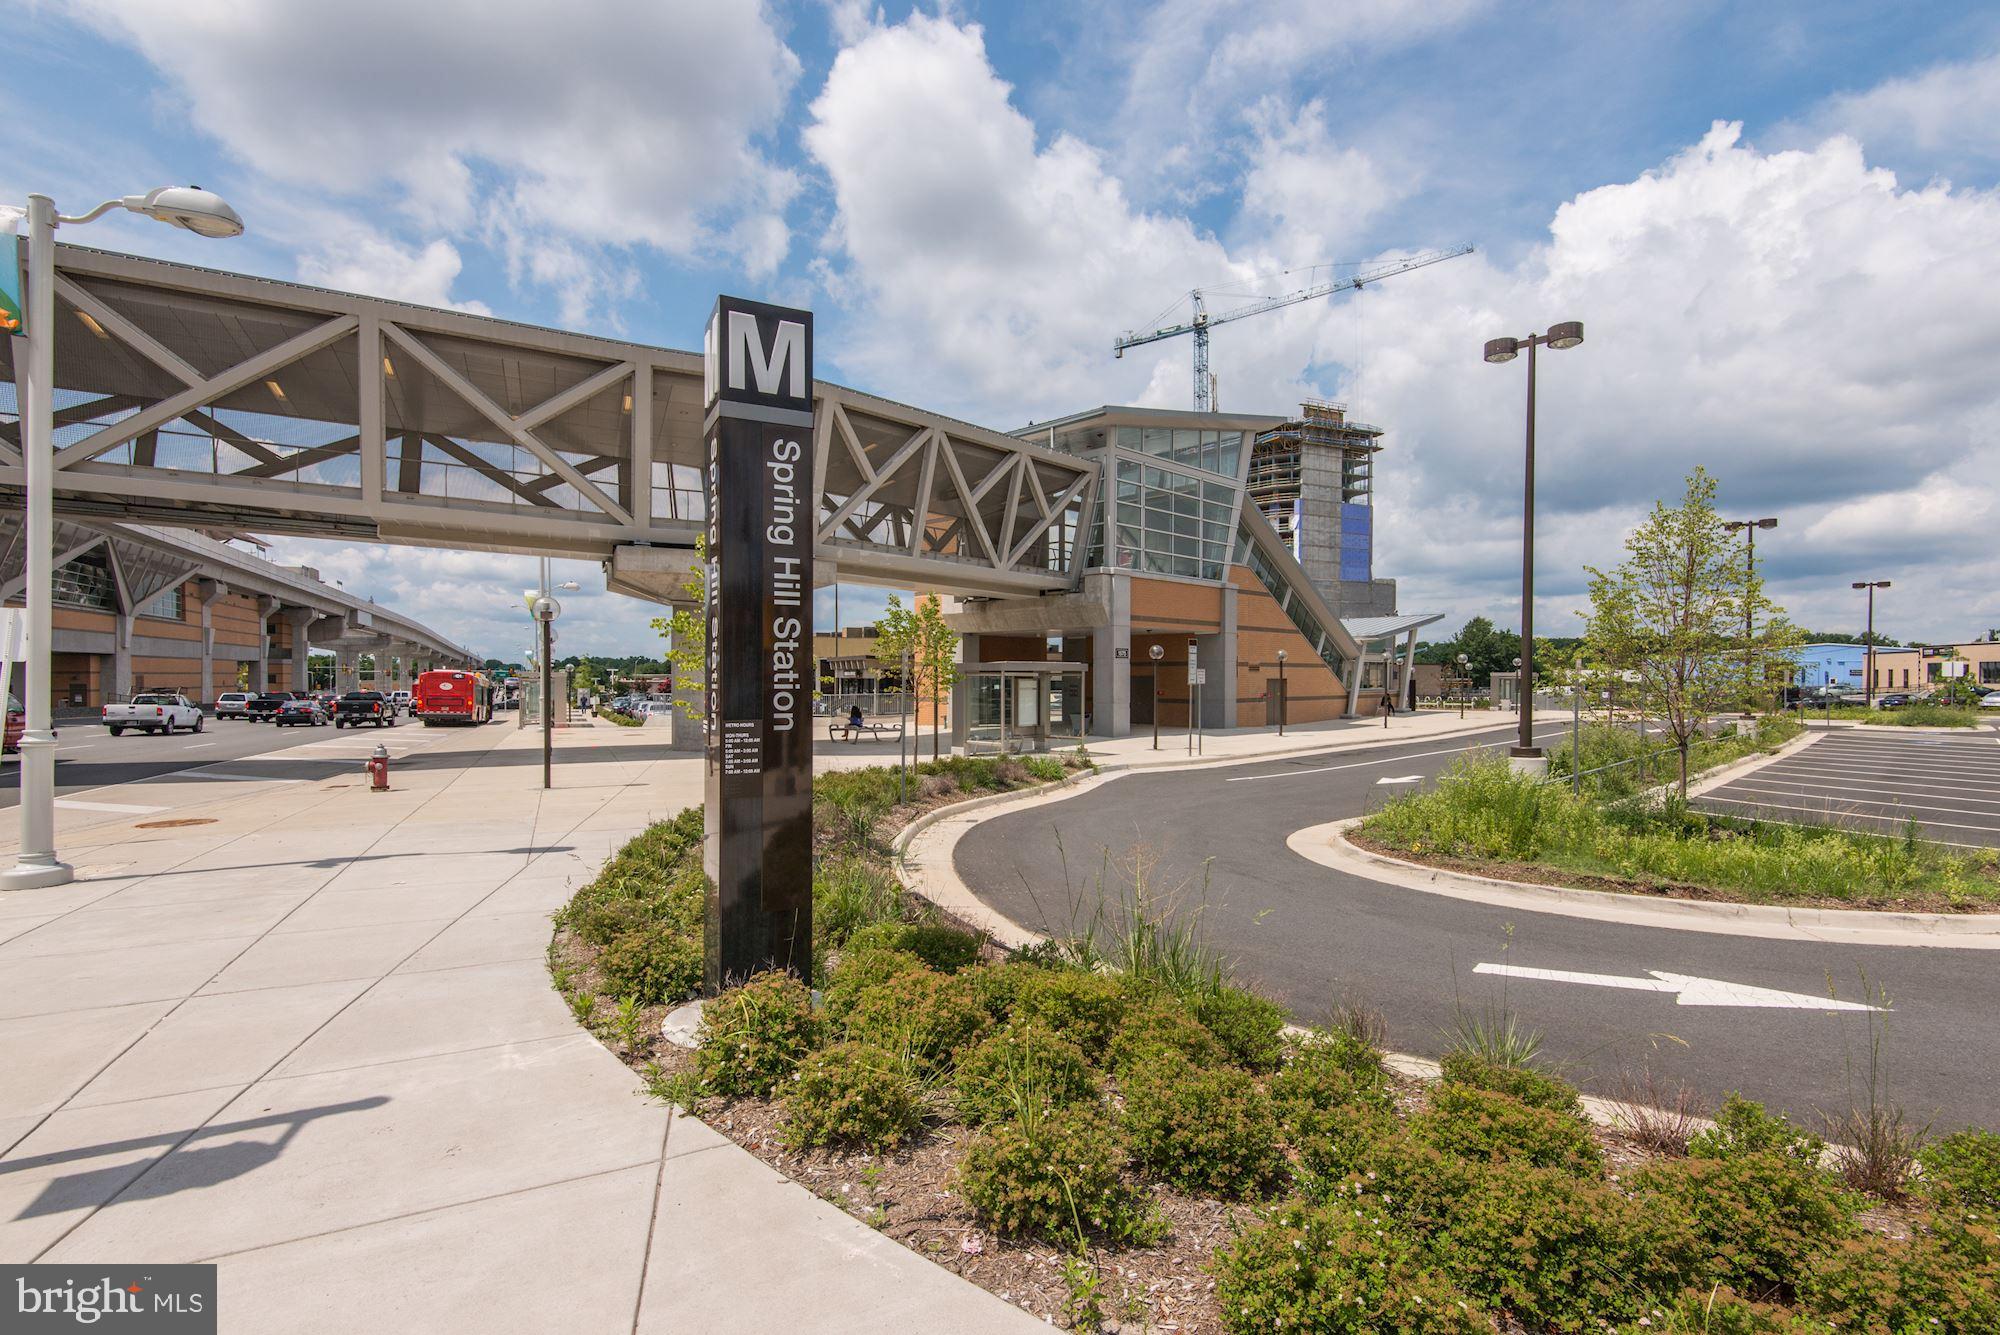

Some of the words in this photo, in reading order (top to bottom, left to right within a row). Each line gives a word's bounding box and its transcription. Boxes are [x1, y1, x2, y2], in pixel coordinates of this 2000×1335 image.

[728, 310, 806, 399] M
[766, 438, 801, 546] Spring
[773, 556, 801, 606] Hill
[773, 616, 802, 731] Station
